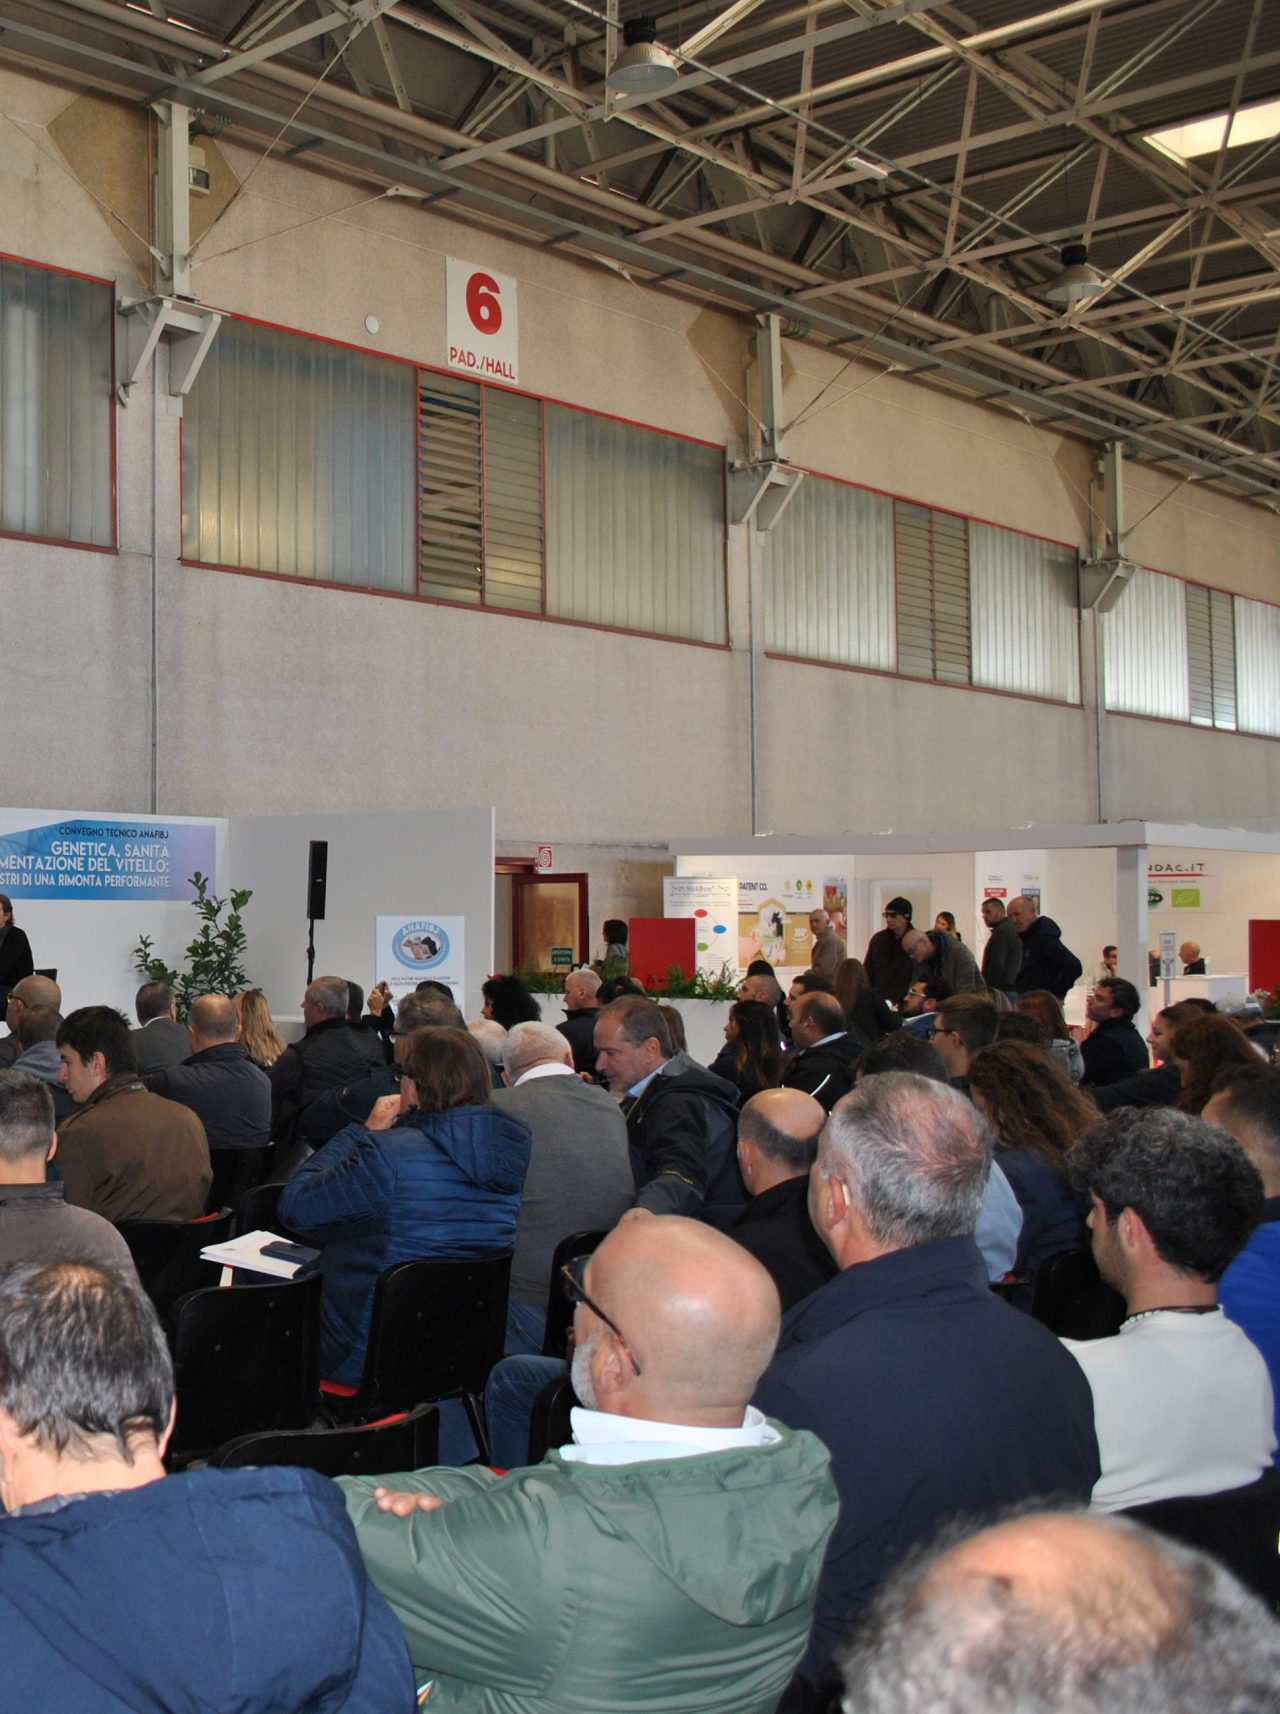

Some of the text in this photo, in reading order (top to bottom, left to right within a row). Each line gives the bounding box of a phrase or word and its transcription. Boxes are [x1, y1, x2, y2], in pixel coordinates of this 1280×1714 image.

[466, 272, 502, 335] 6
[449, 346, 516, 380] PAD./HALL
[58, 825, 104, 837] CONVEGNO
[106, 827, 138, 839] TECNICO
[51, 841, 170, 859] GENETICA, SANITÀ
[88, 857, 112, 873] DEL
[115, 858, 170, 874] VITELLO:
[23, 873, 32, 887] DI
[35, 874, 56, 887] UNA
[58, 874, 102, 888] RIMONTA
[105, 875, 170, 889] PERFORMANTE
[402, 922, 440, 936] ANAFIBJ
